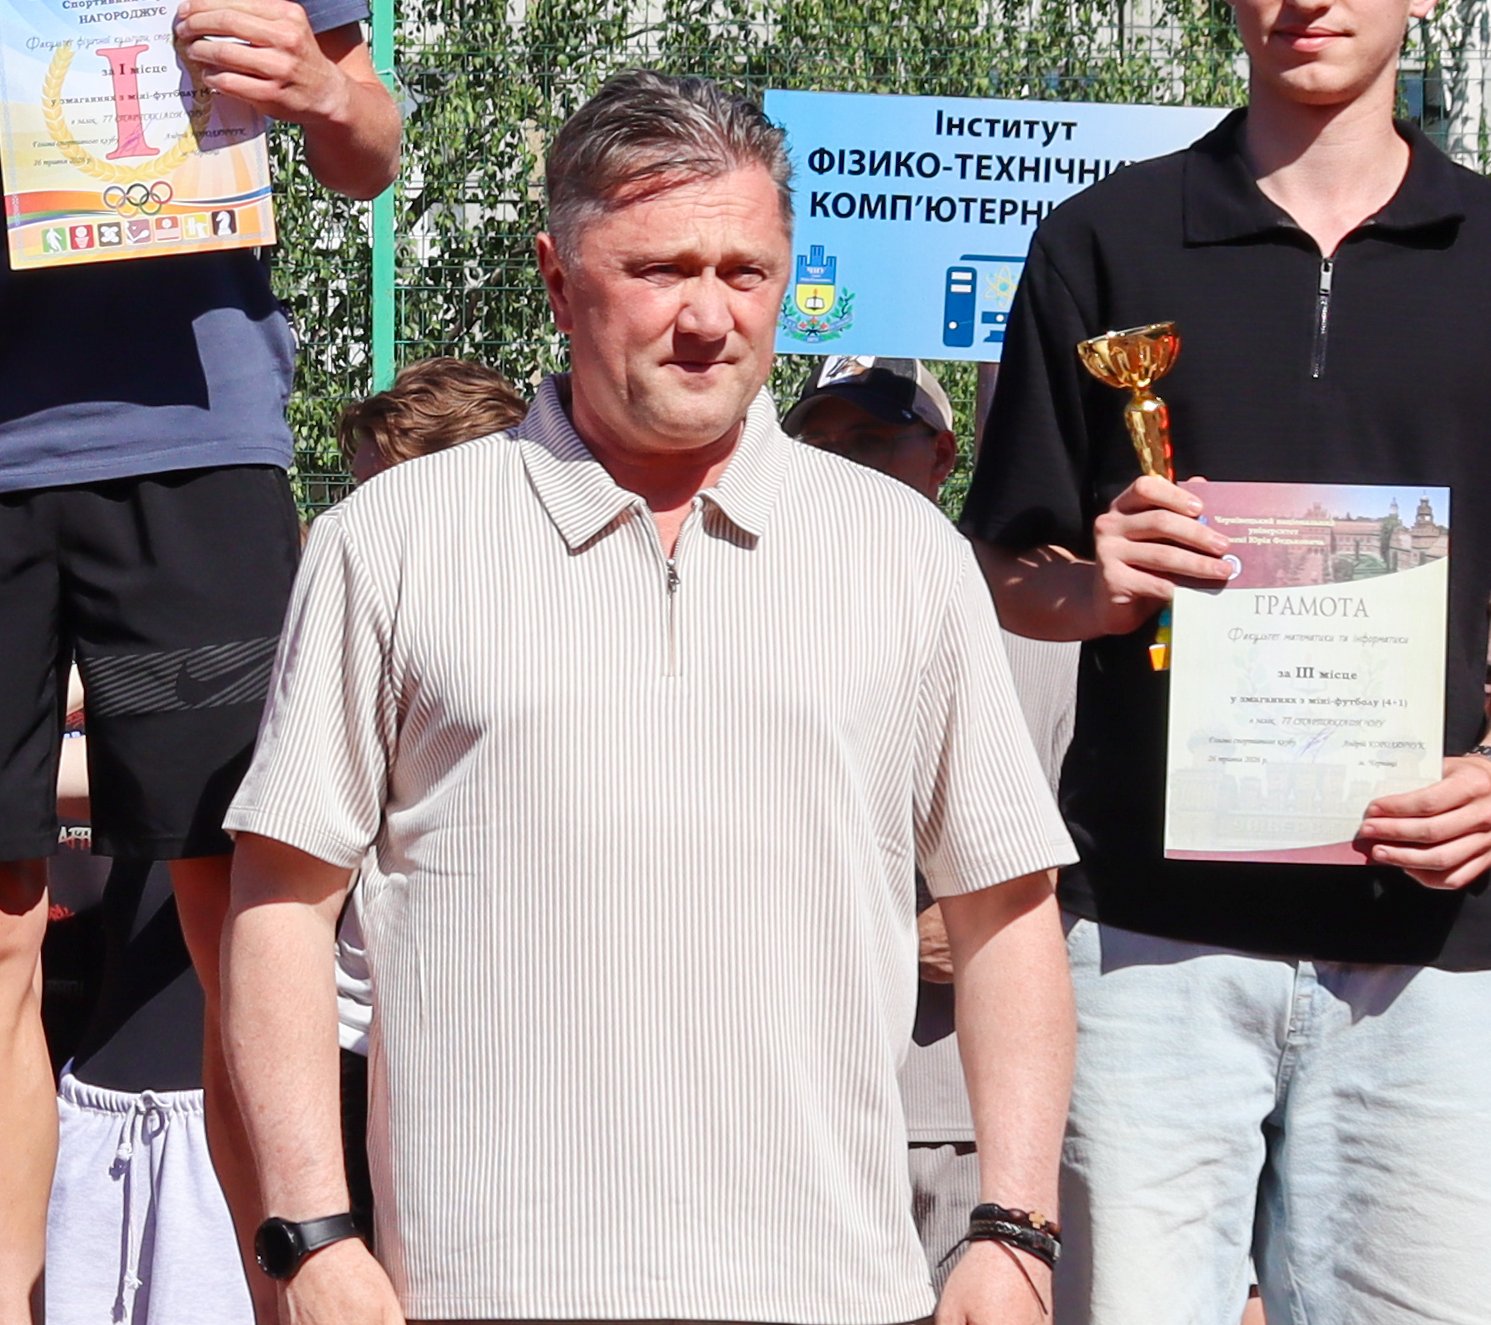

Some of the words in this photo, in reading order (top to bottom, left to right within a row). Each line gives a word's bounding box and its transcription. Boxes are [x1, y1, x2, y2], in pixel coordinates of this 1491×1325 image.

[79, 6, 167, 24] НАГОРОДЖУЄ
[130, 65, 167, 75] місце
[935, 109, 1078, 147] Інститут
[807, 148, 1136, 185] ФІЗИКО-ТЕХНІЧН
[1254, 595, 1369, 618] ГРАМОТА
[1319, 670, 1357, 680] місце
